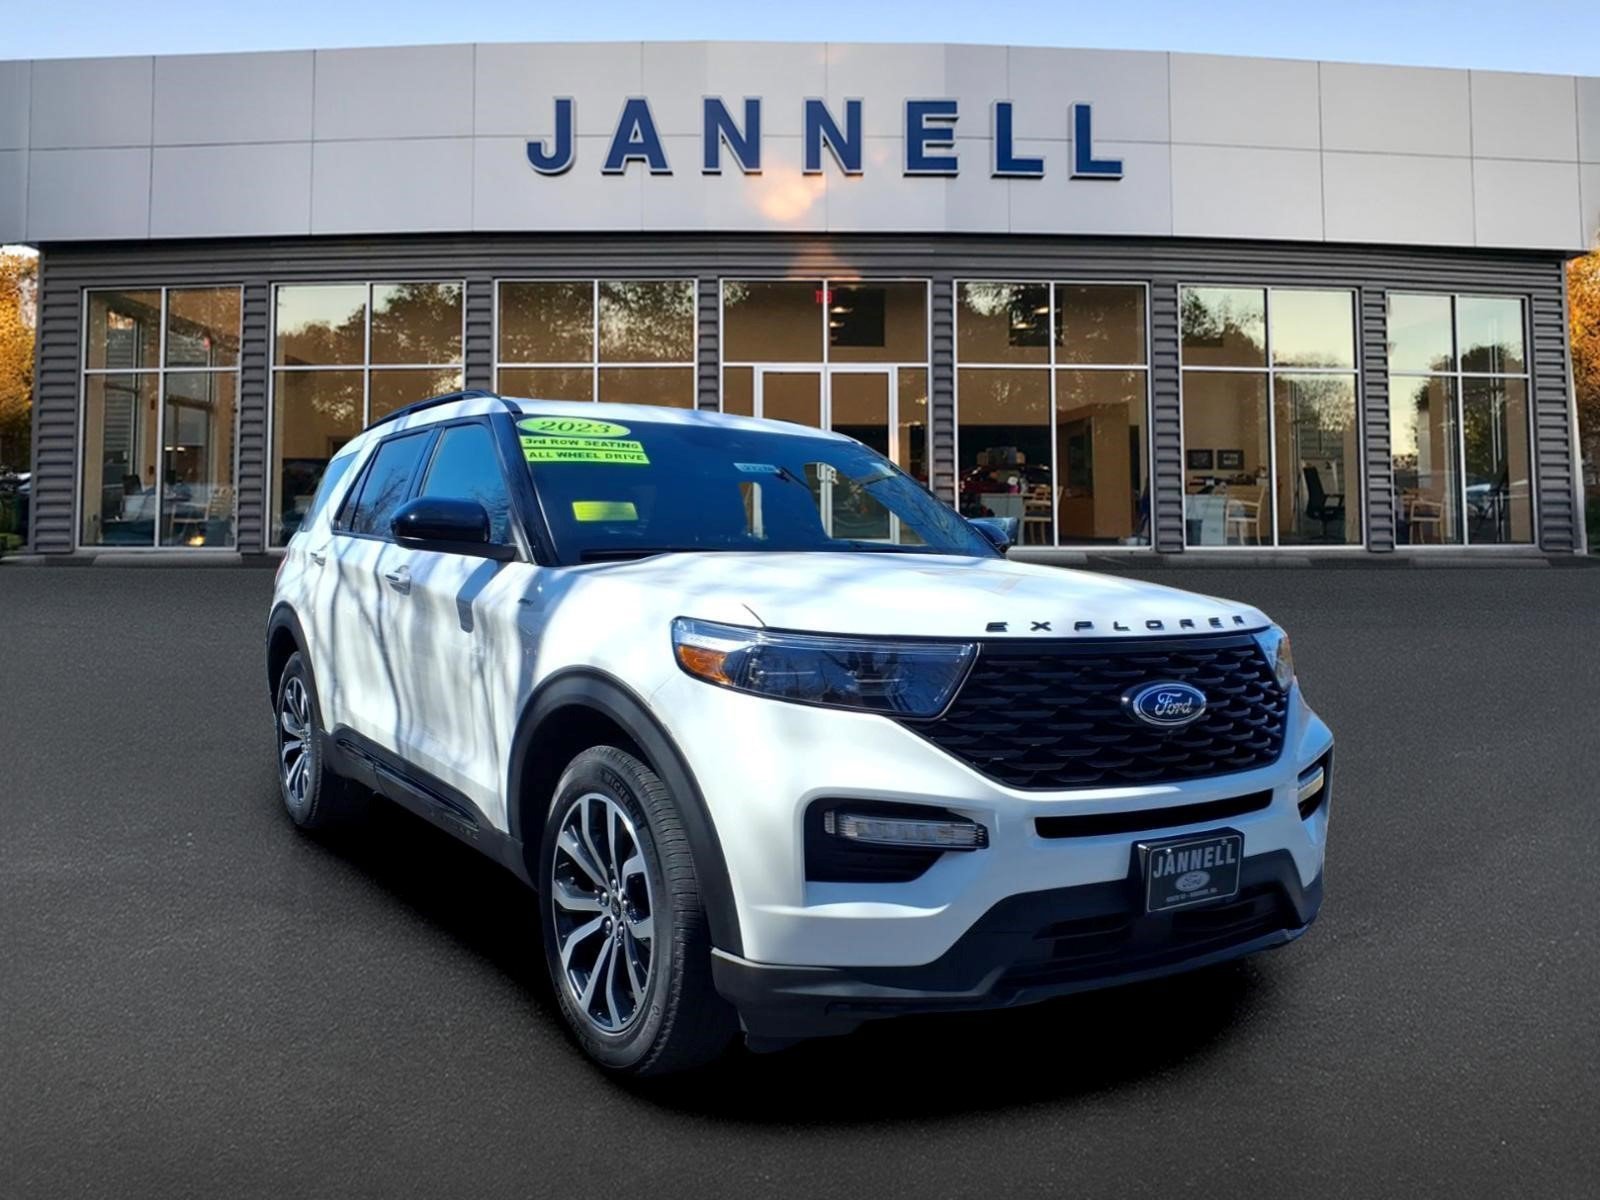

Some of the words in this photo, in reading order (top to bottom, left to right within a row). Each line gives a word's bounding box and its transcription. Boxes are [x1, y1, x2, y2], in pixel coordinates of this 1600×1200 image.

[526, 96, 1124, 179] JANNELL
[538, 420, 611, 434] 2023
[584, 440, 640, 449] SEATING
[529, 451, 553, 459] ALL
[556, 451, 600, 459] WHEEL
[605, 453, 645, 461] DRIVE
[985, 615, 1244, 632] EXPLORER
[1154, 692, 1192, 716] Ford
[1152, 843, 1236, 878] JANNELL
